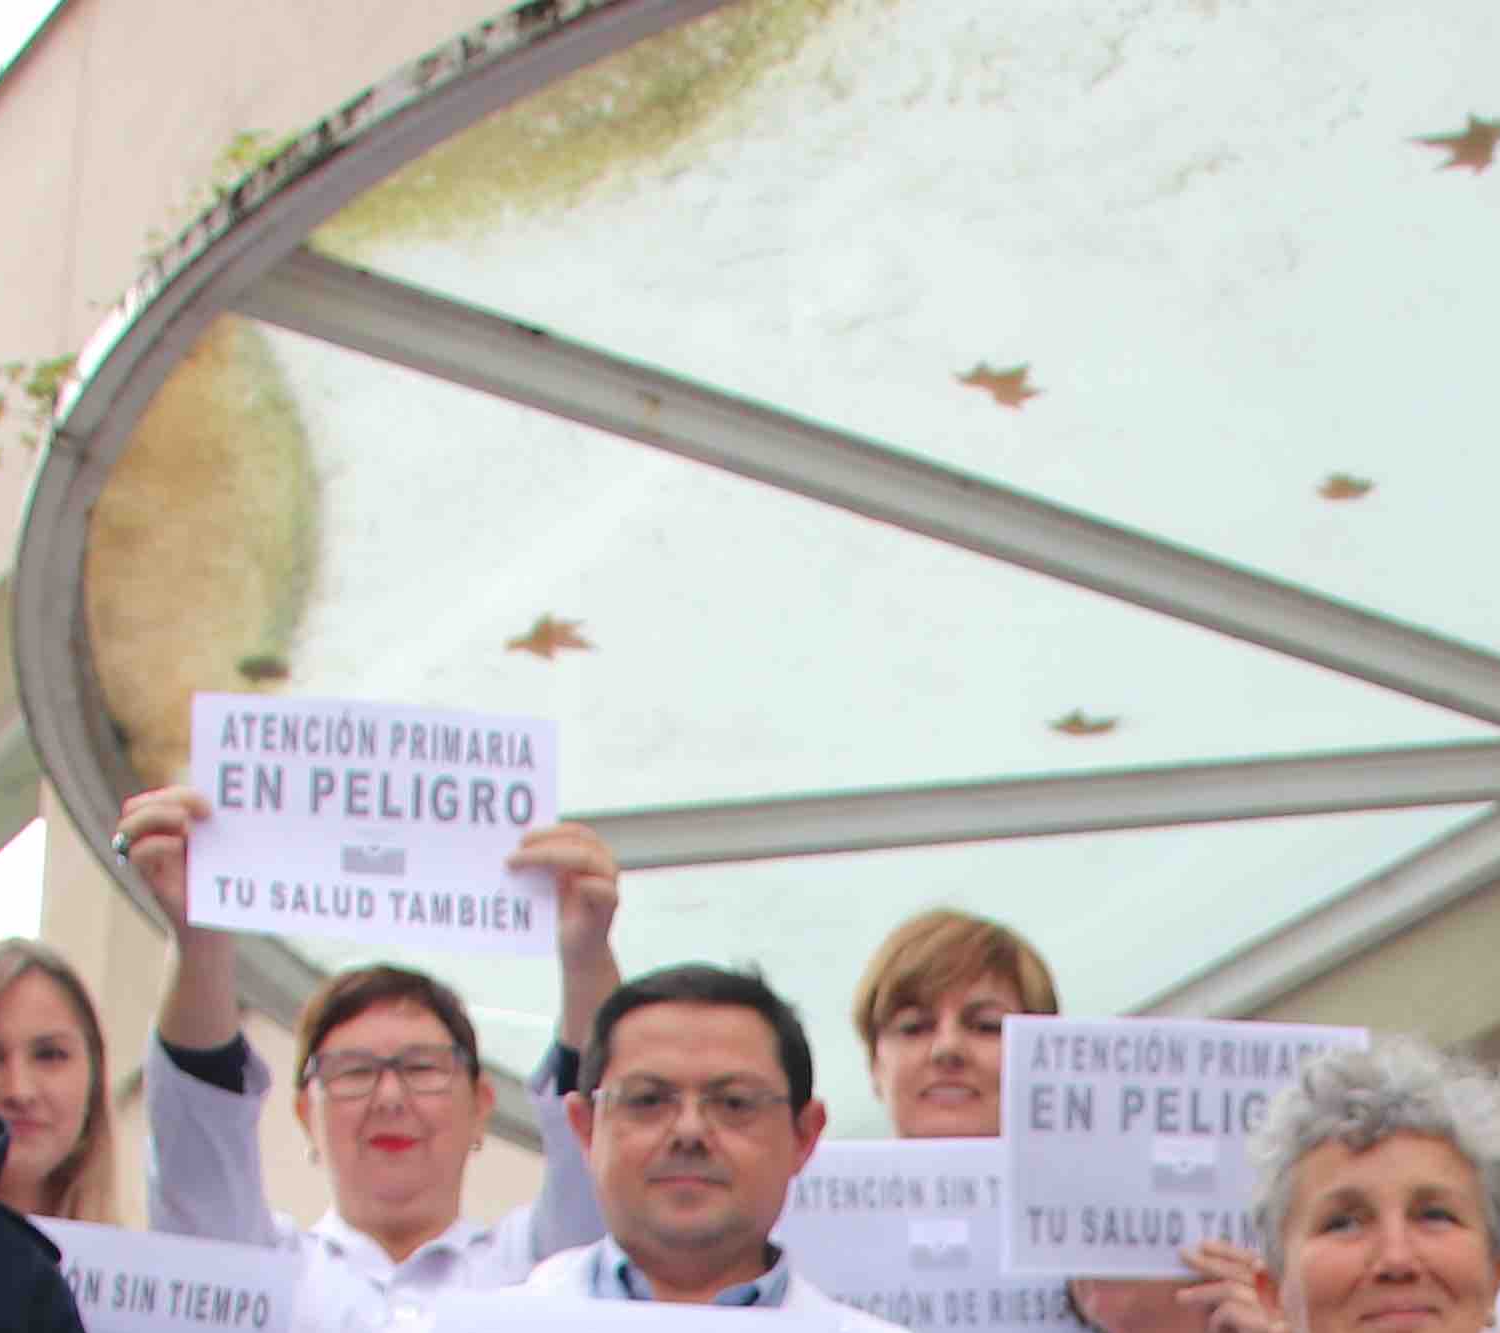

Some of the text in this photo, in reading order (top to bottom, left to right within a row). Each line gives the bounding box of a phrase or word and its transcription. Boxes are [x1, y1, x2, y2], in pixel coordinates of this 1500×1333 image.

[222, 711, 534, 769] ATENCIÓN PRIMARIA
[218, 763, 534, 825] EN PELIGRO
[216, 877, 254, 909] TU
[271, 881, 373, 920] SALUD
[1031, 1029, 1325, 1076] ATENCIÓN PRIMA
[1030, 1084, 1267, 1134] EN PELIG
[1027, 1206, 1067, 1245] TU
[1082, 1207, 1184, 1246] SALUD
[113, 1271, 156, 1312] SIN
[169, 1279, 270, 1328] TIEMPO
[944, 1289, 976, 1325] DE
[989, 1288, 1067, 1326] RIESG
